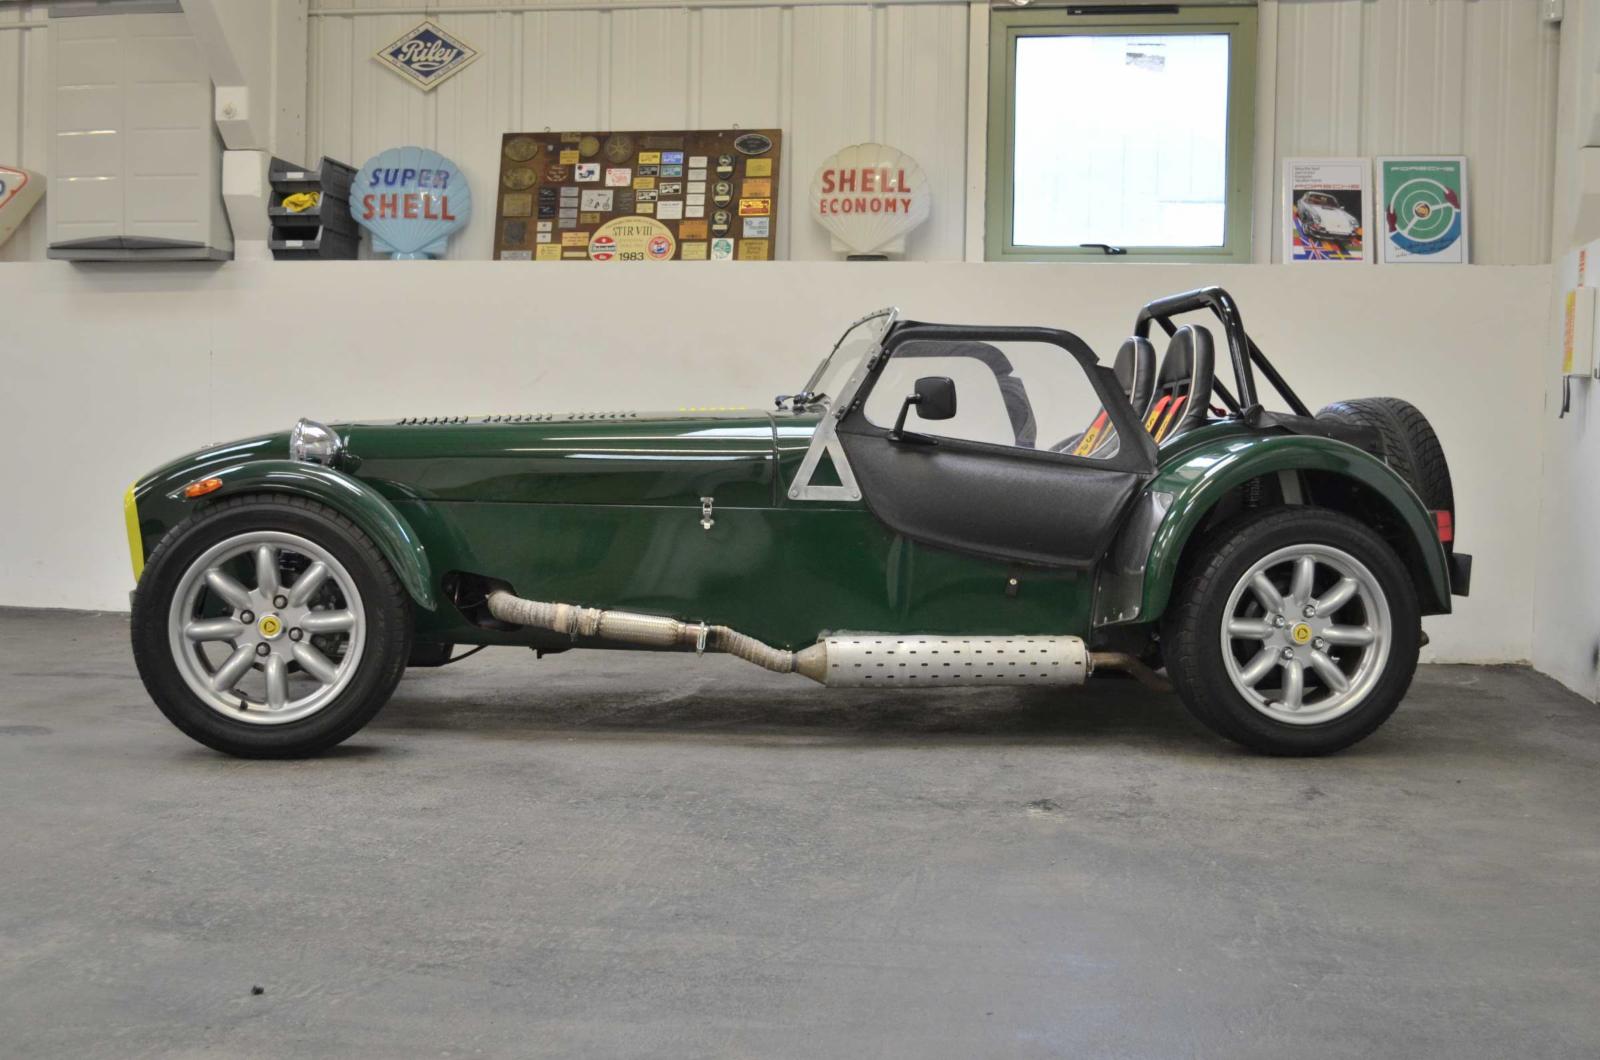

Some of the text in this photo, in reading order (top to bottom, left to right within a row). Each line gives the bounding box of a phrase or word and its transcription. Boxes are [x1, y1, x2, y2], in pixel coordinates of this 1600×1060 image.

[397, 39, 460, 71] Riley
[369, 168, 450, 189] SUPER
[822, 168, 911, 193] SHELL
[362, 193, 456, 221] SHELL
[820, 198, 912, 214] ECONOMY
[618, 251, 645, 261] 1983
